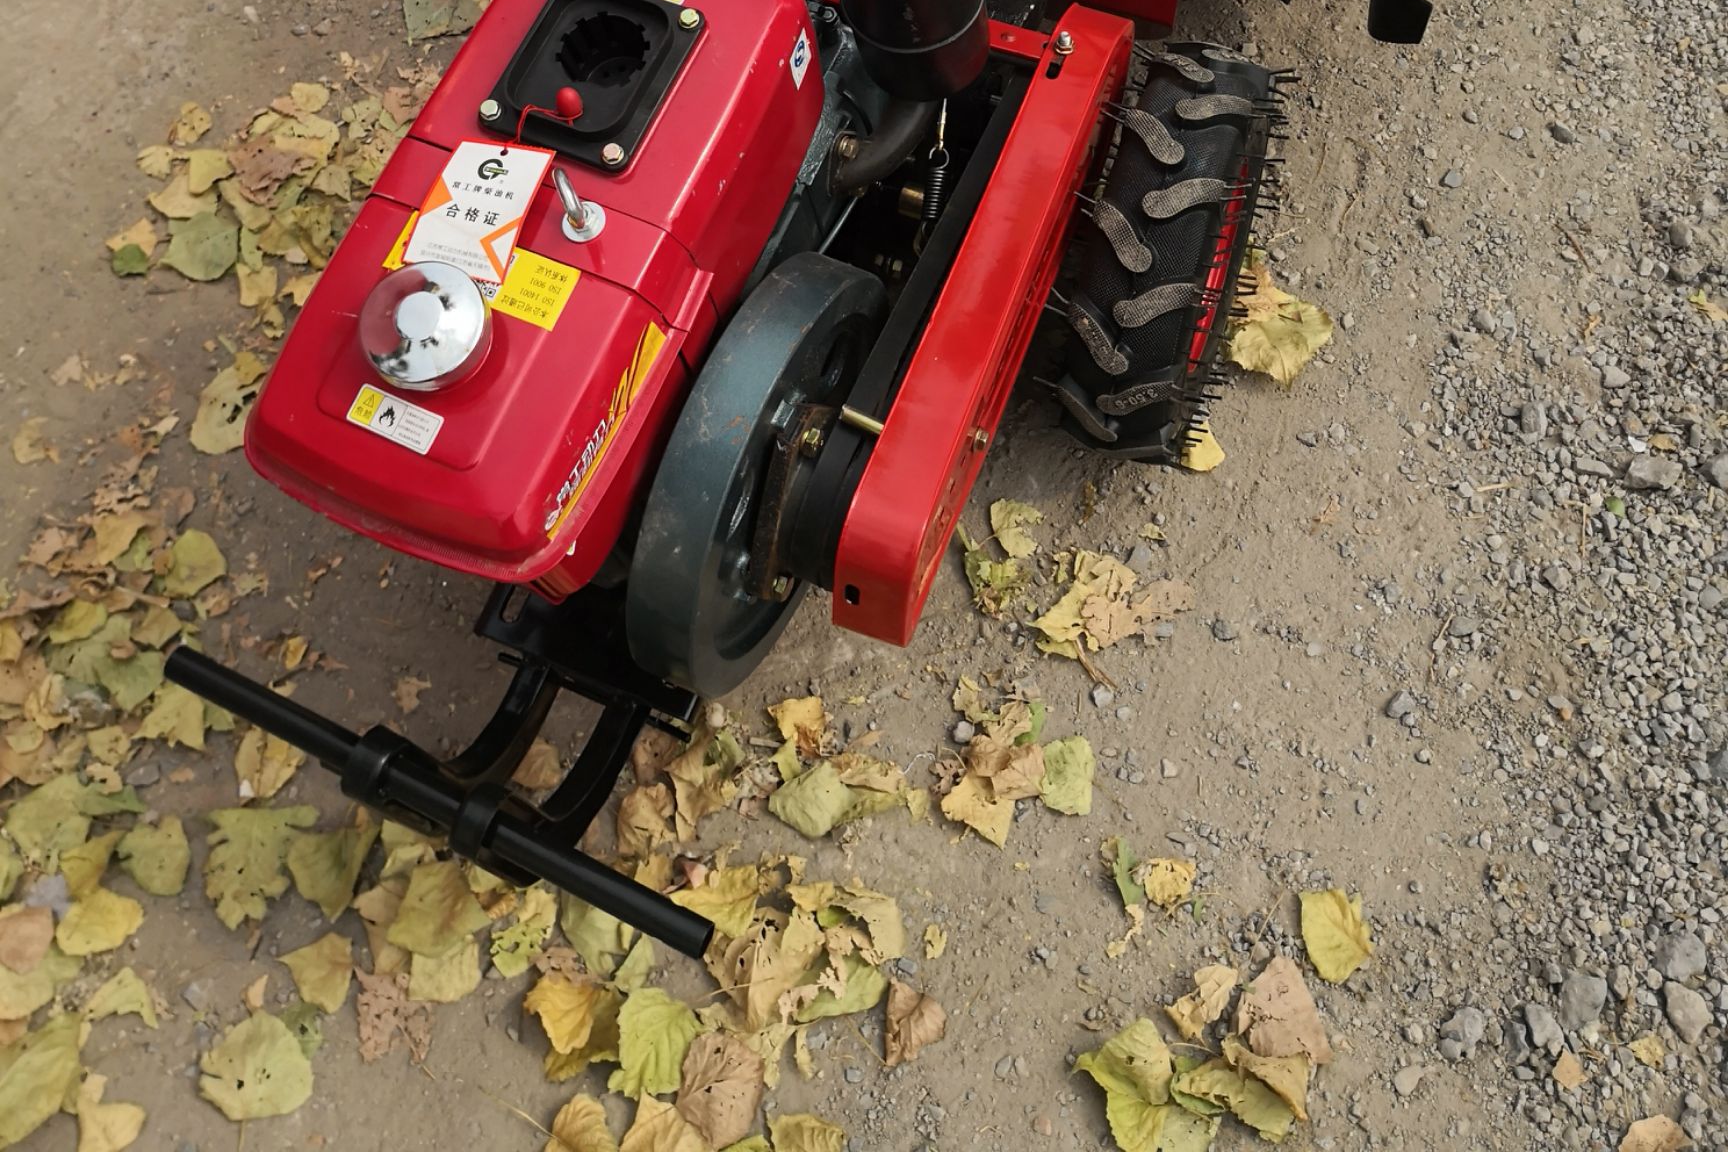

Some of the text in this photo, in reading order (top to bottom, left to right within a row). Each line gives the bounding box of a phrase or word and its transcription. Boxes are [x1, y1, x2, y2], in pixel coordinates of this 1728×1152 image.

[446, 204, 500, 226] 合格证
[529, 278, 562, 295] ISO 9001
[519, 288, 555, 306] ISO 14001
